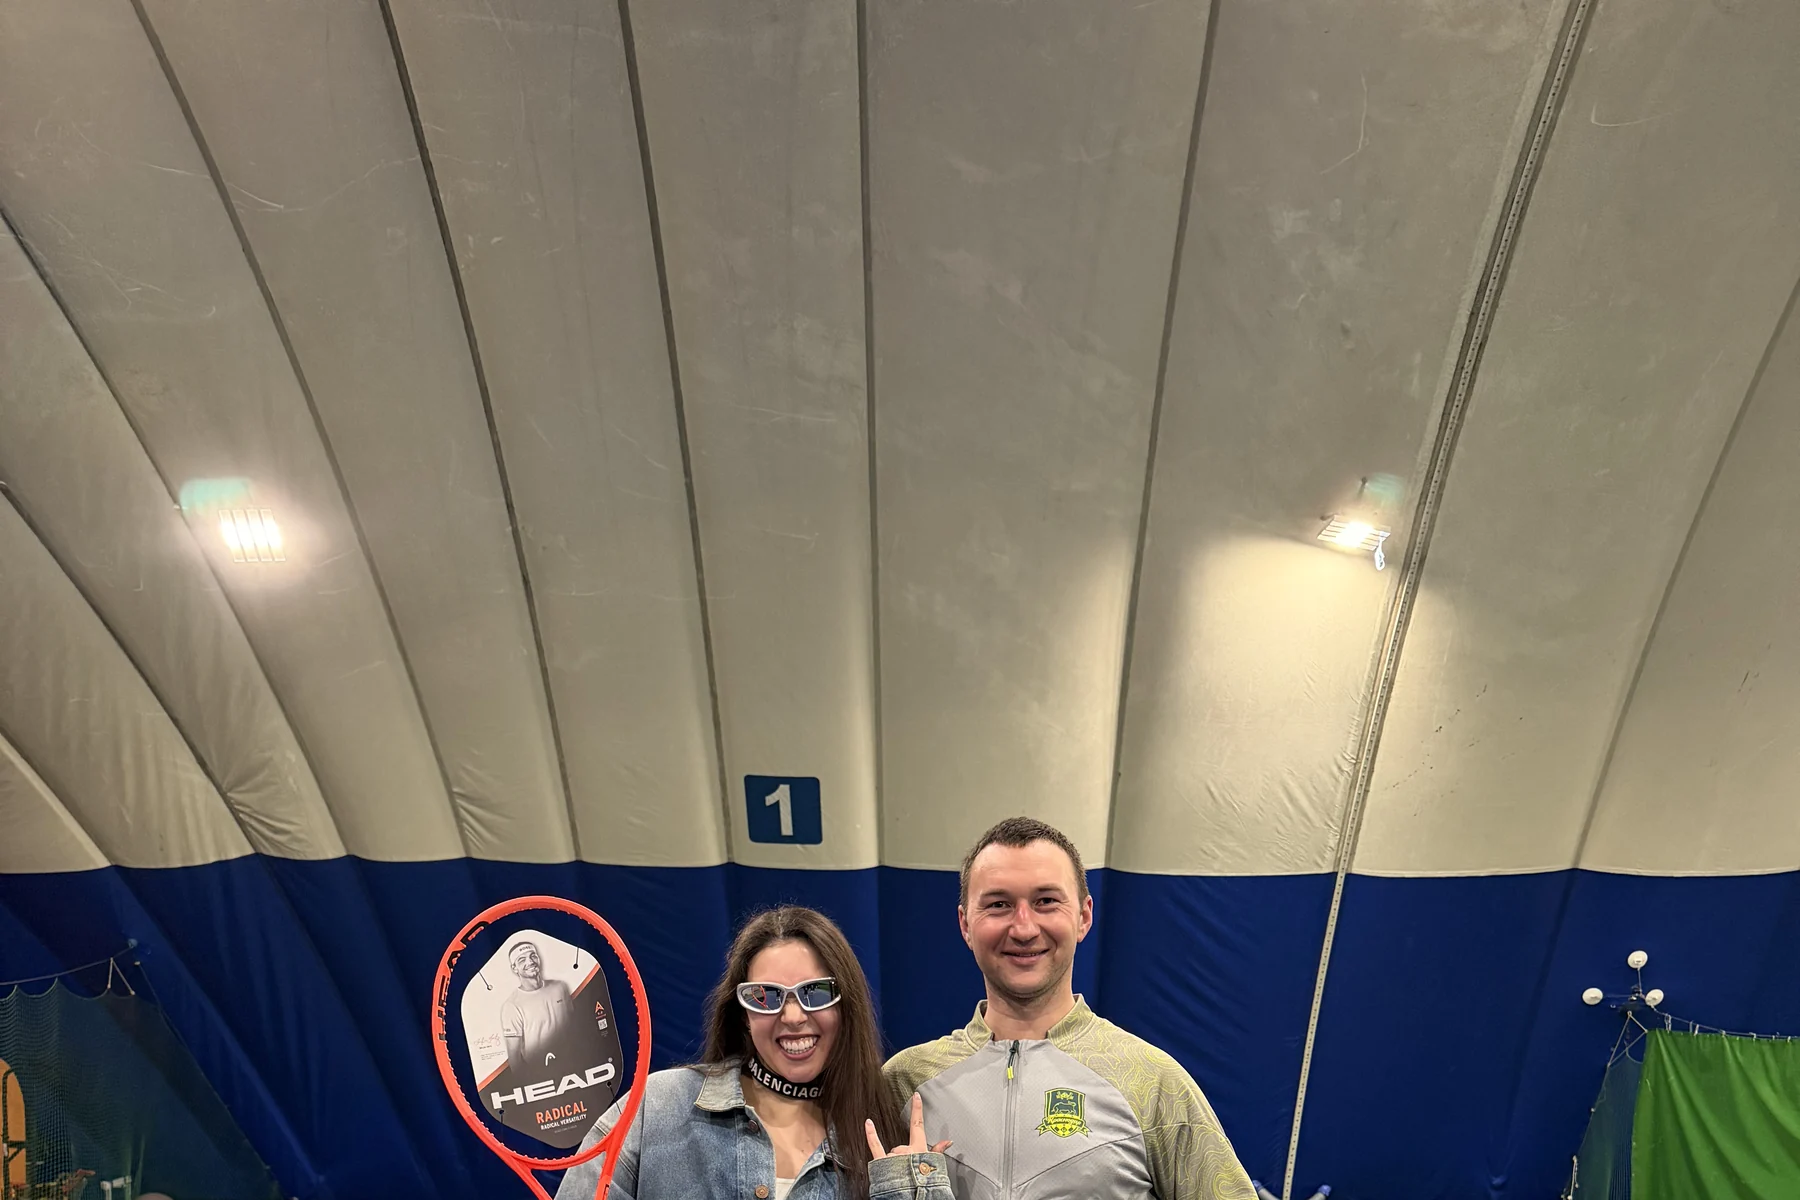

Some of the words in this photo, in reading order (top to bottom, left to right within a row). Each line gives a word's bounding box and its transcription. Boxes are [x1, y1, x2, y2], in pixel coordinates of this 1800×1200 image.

[765, 784, 793, 836] 1
[490, 1062, 616, 1110] HEAD
[535, 1101, 588, 1124] RADICAL
[540, 1121, 560, 1130] RADICAL
[560, 1114, 587, 1126] VERSATILITY
